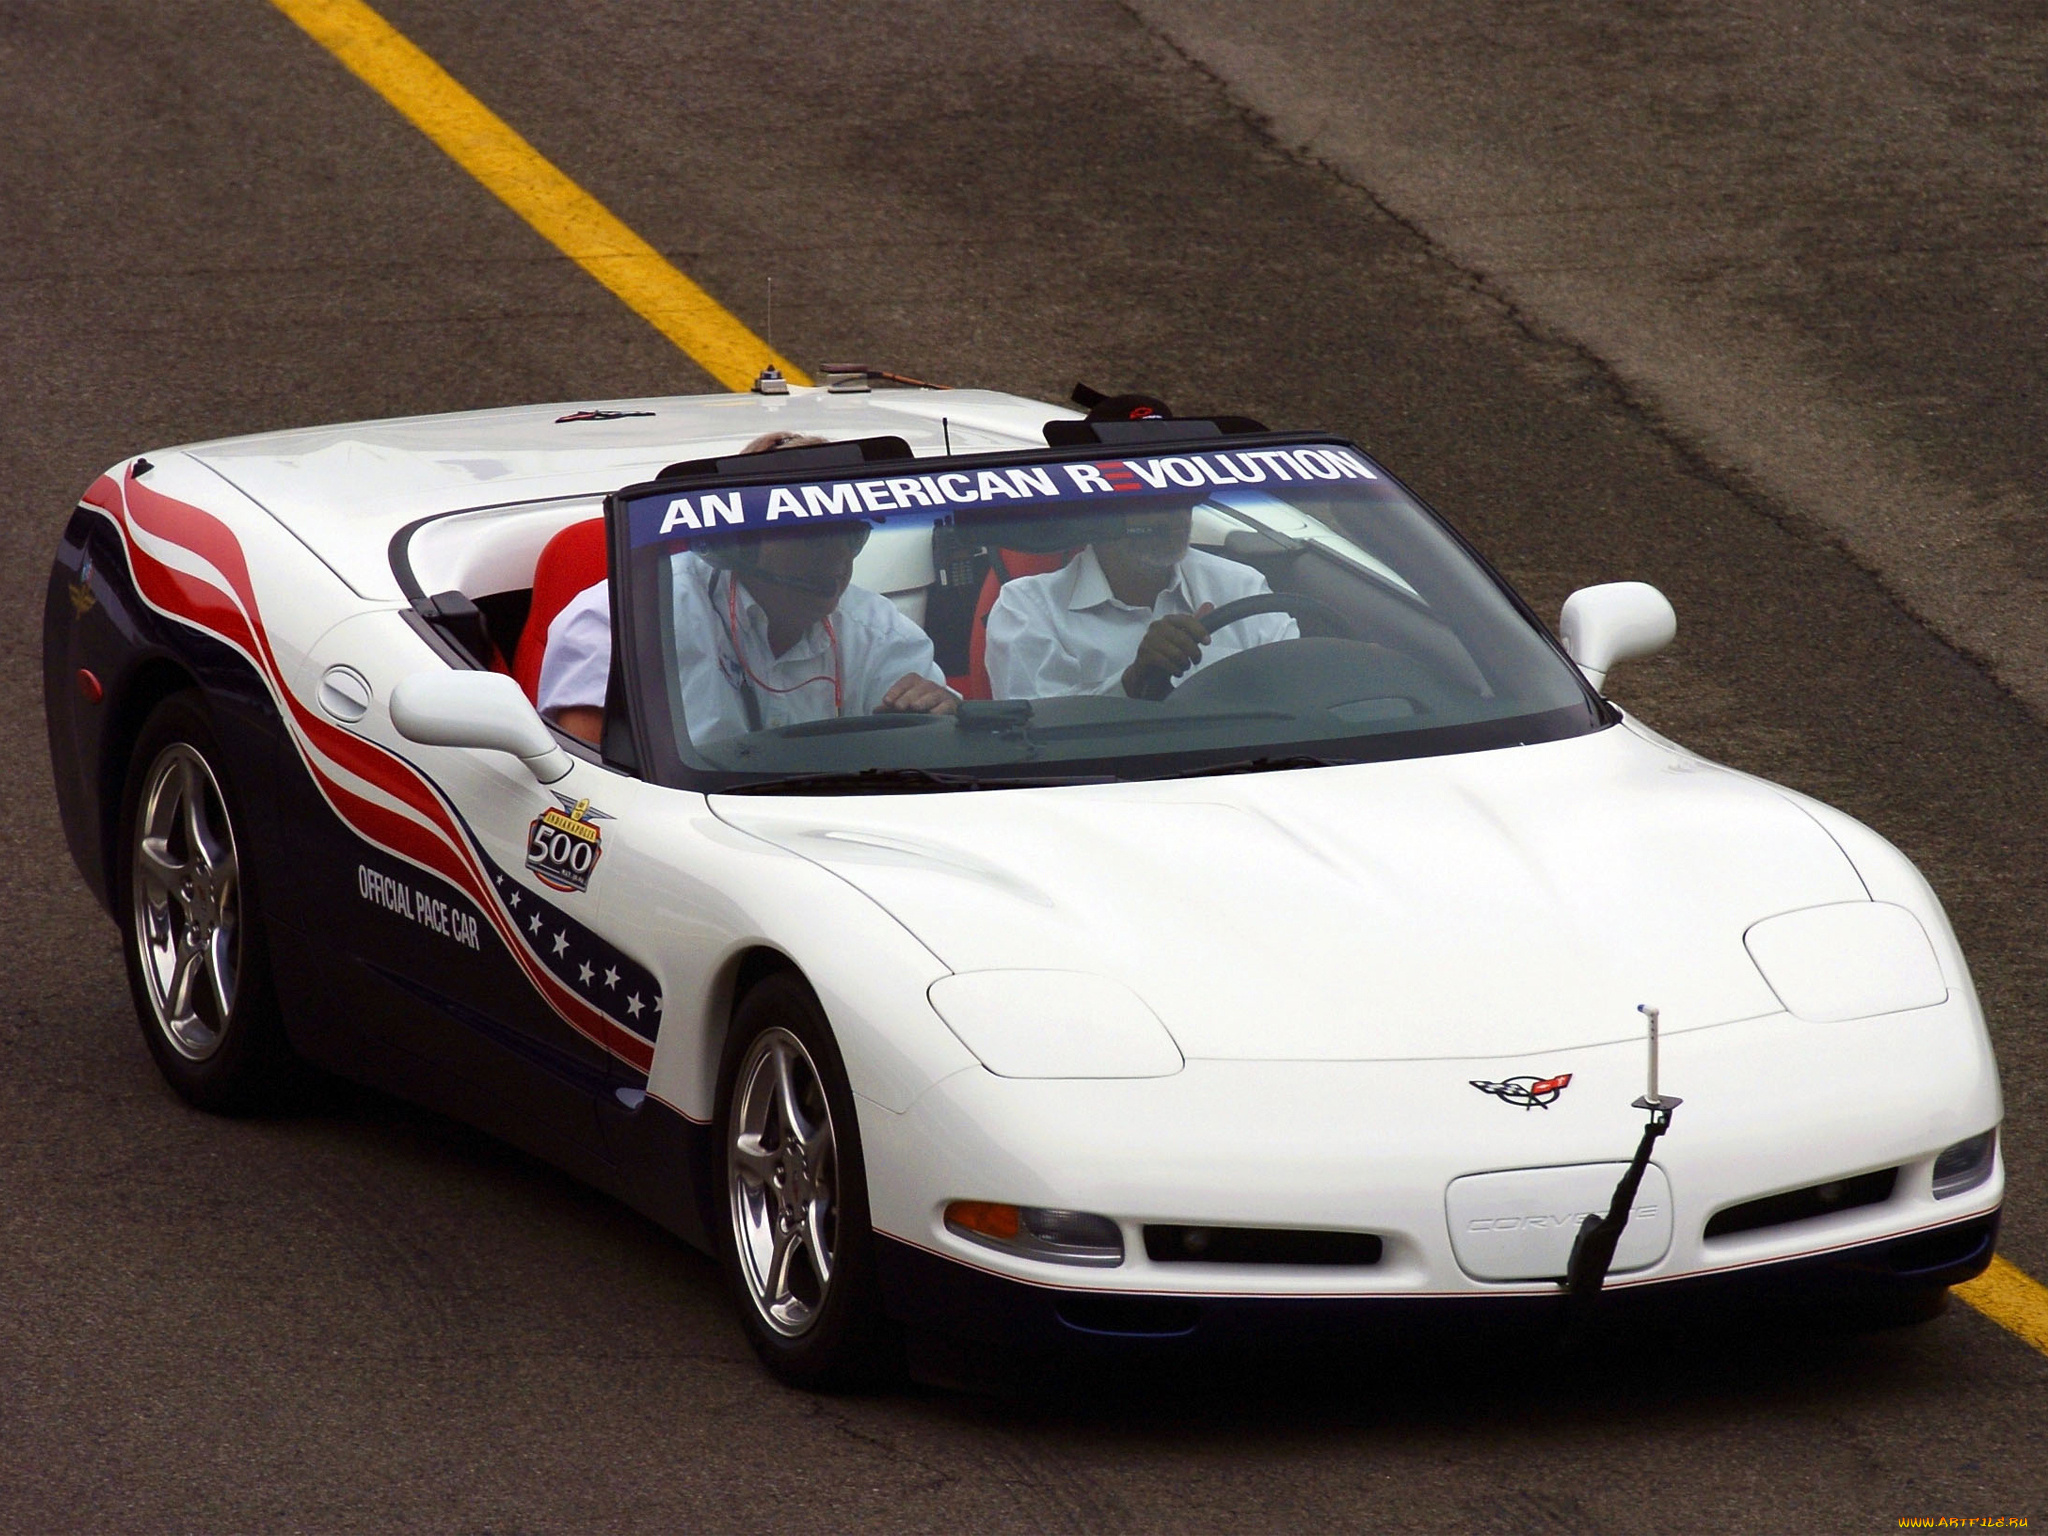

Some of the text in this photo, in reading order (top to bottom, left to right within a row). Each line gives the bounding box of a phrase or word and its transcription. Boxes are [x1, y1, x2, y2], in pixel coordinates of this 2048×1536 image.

[659, 449, 1378, 534] AN AMERICAN REVOLUTION
[528, 824, 593, 874] 500
[358, 864, 480, 951] OFFICIAL PACE CAR
